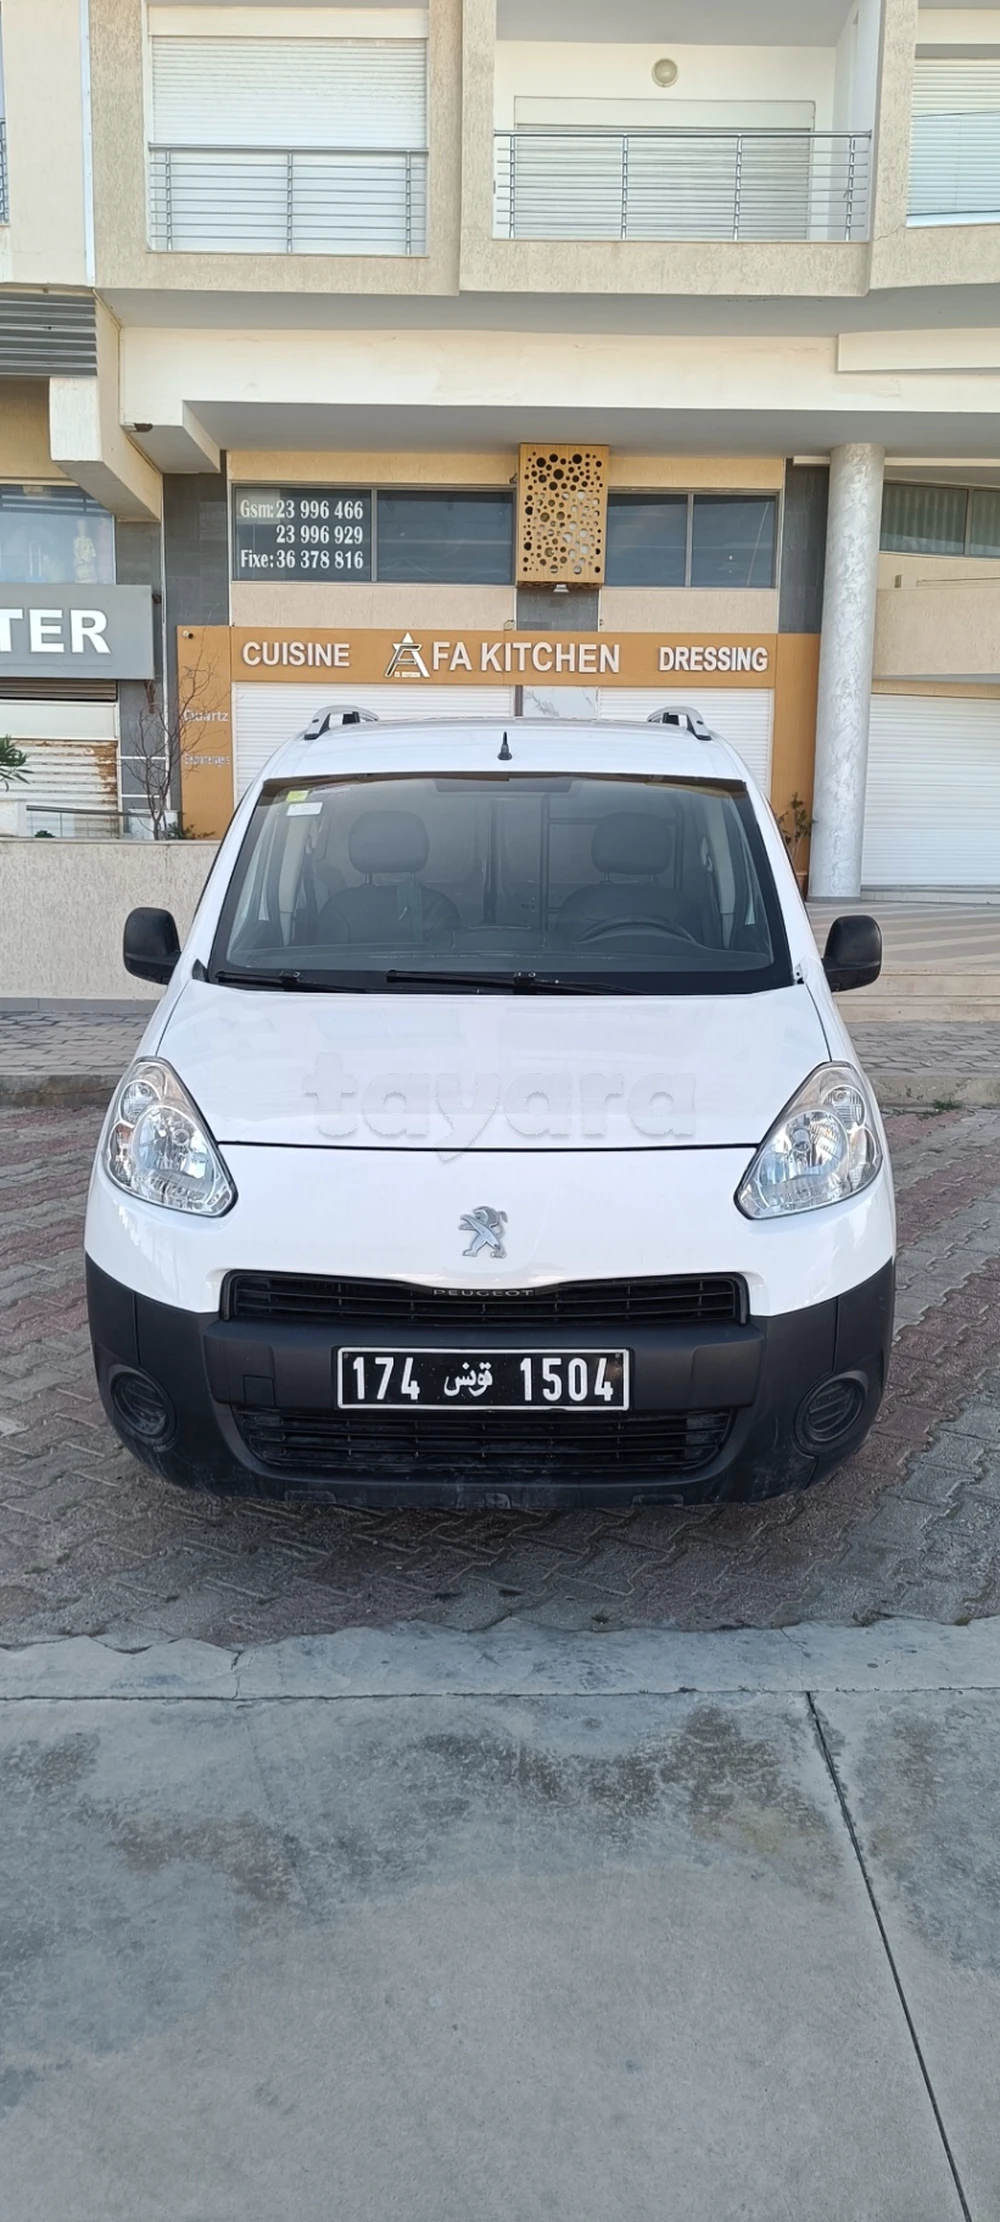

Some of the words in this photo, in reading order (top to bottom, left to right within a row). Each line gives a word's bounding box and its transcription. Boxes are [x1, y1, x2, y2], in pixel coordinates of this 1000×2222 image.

[300, 500, 329, 519] 996
[334, 500, 363, 519] 466
[276, 525, 295, 543] 23
[300, 525, 329, 544] 996
[334, 526, 363, 544] 929
[300, 550, 329, 569] 378
[334, 551, 363, 569] 816
[0, 608, 111, 653] TER
[242, 641, 350, 666] CUISINE
[481, 641, 620, 673] KITCHEN
[659, 646, 768, 671] DRESSING
[432, 1288, 535, 1297] PEUGEOT
[353, 1356, 420, 1400] 174
[443, 1361, 493, 1397] تونس
[519, 1357, 614, 1401] 1504
